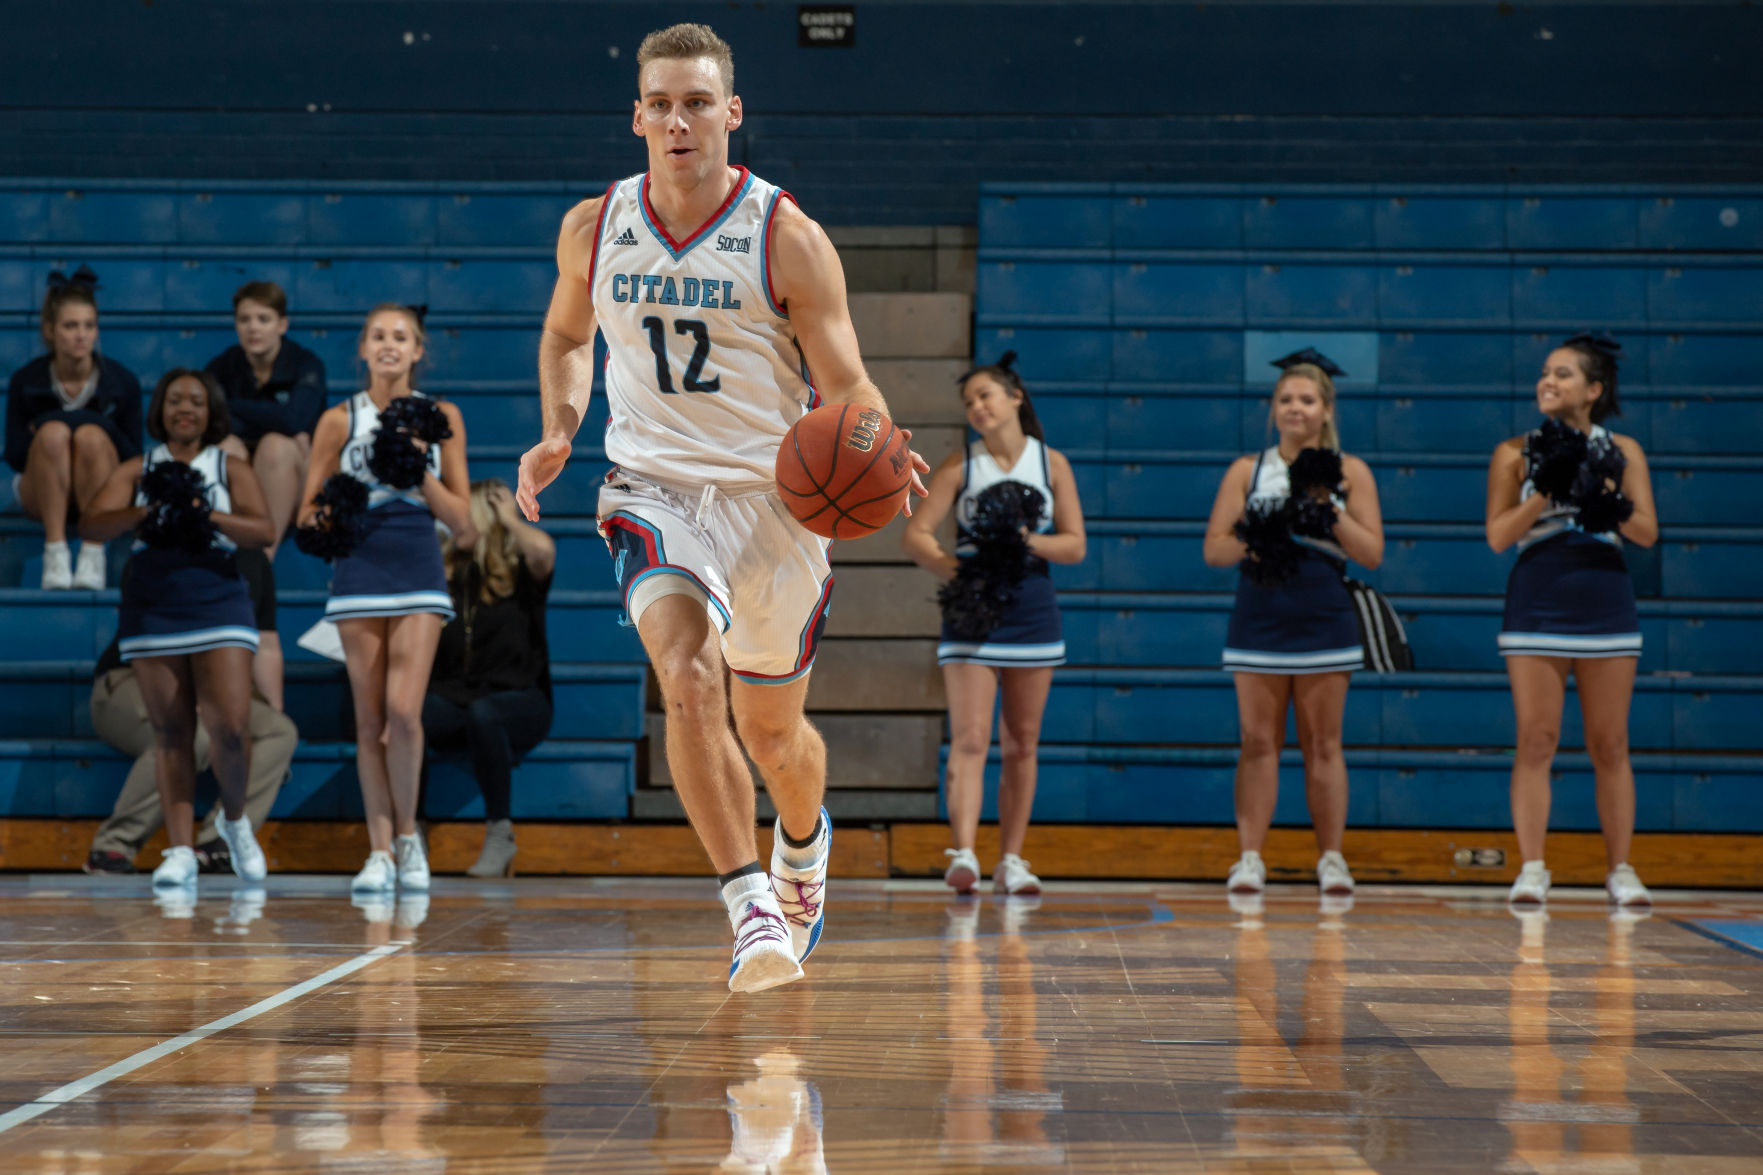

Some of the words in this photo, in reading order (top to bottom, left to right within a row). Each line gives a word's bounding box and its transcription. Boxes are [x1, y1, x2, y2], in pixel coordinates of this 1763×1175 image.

[800, 12, 854, 27] CADETS
[808, 27, 846, 40] ONLY
[613, 237, 639, 246] adidas
[716, 234, 752, 254] SOCON
[612, 273, 741, 310] CITADEL
[642, 315, 721, 394] 12
